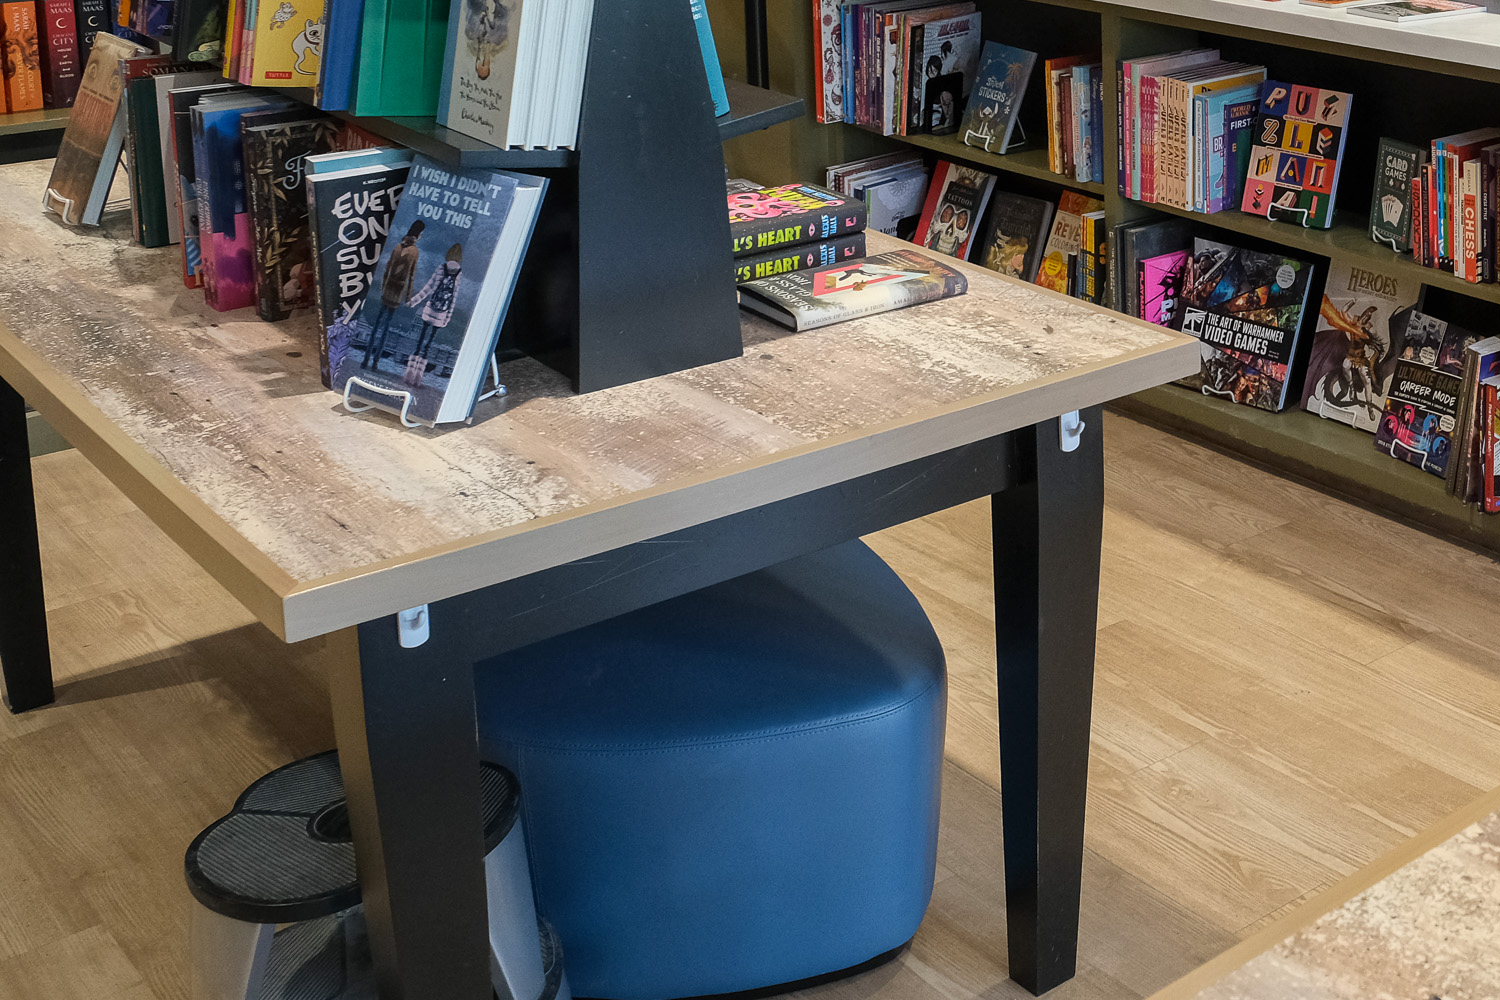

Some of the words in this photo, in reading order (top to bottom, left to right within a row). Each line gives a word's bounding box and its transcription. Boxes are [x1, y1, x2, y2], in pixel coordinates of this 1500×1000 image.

[1385, 166, 1407, 181] GAMES
[1386, 155, 1408, 171] CARD
[420, 166, 449, 186] WISH
[458, 177, 502, 199] DIDN'T
[409, 182, 440, 201] HAVE
[443, 189, 462, 206] TO
[463, 196, 492, 217] TELL
[416, 201, 444, 219] YOU
[445, 209, 473, 229] THIS
[758, 225, 801, 248] HEART
[1465, 206, 1475, 259] CHESS
[755, 255, 800, 278] HEART
[1347, 267, 1398, 297] HEROES
[1204, 325, 1232, 346] VIDEO
[1234, 334, 1268, 355] GAMES
[1207, 313, 1219, 325] THE
[1220, 317, 1232, 330] ART
[1232, 320, 1242, 332] OF
[1243, 321, 1285, 344] WARHAMMER
